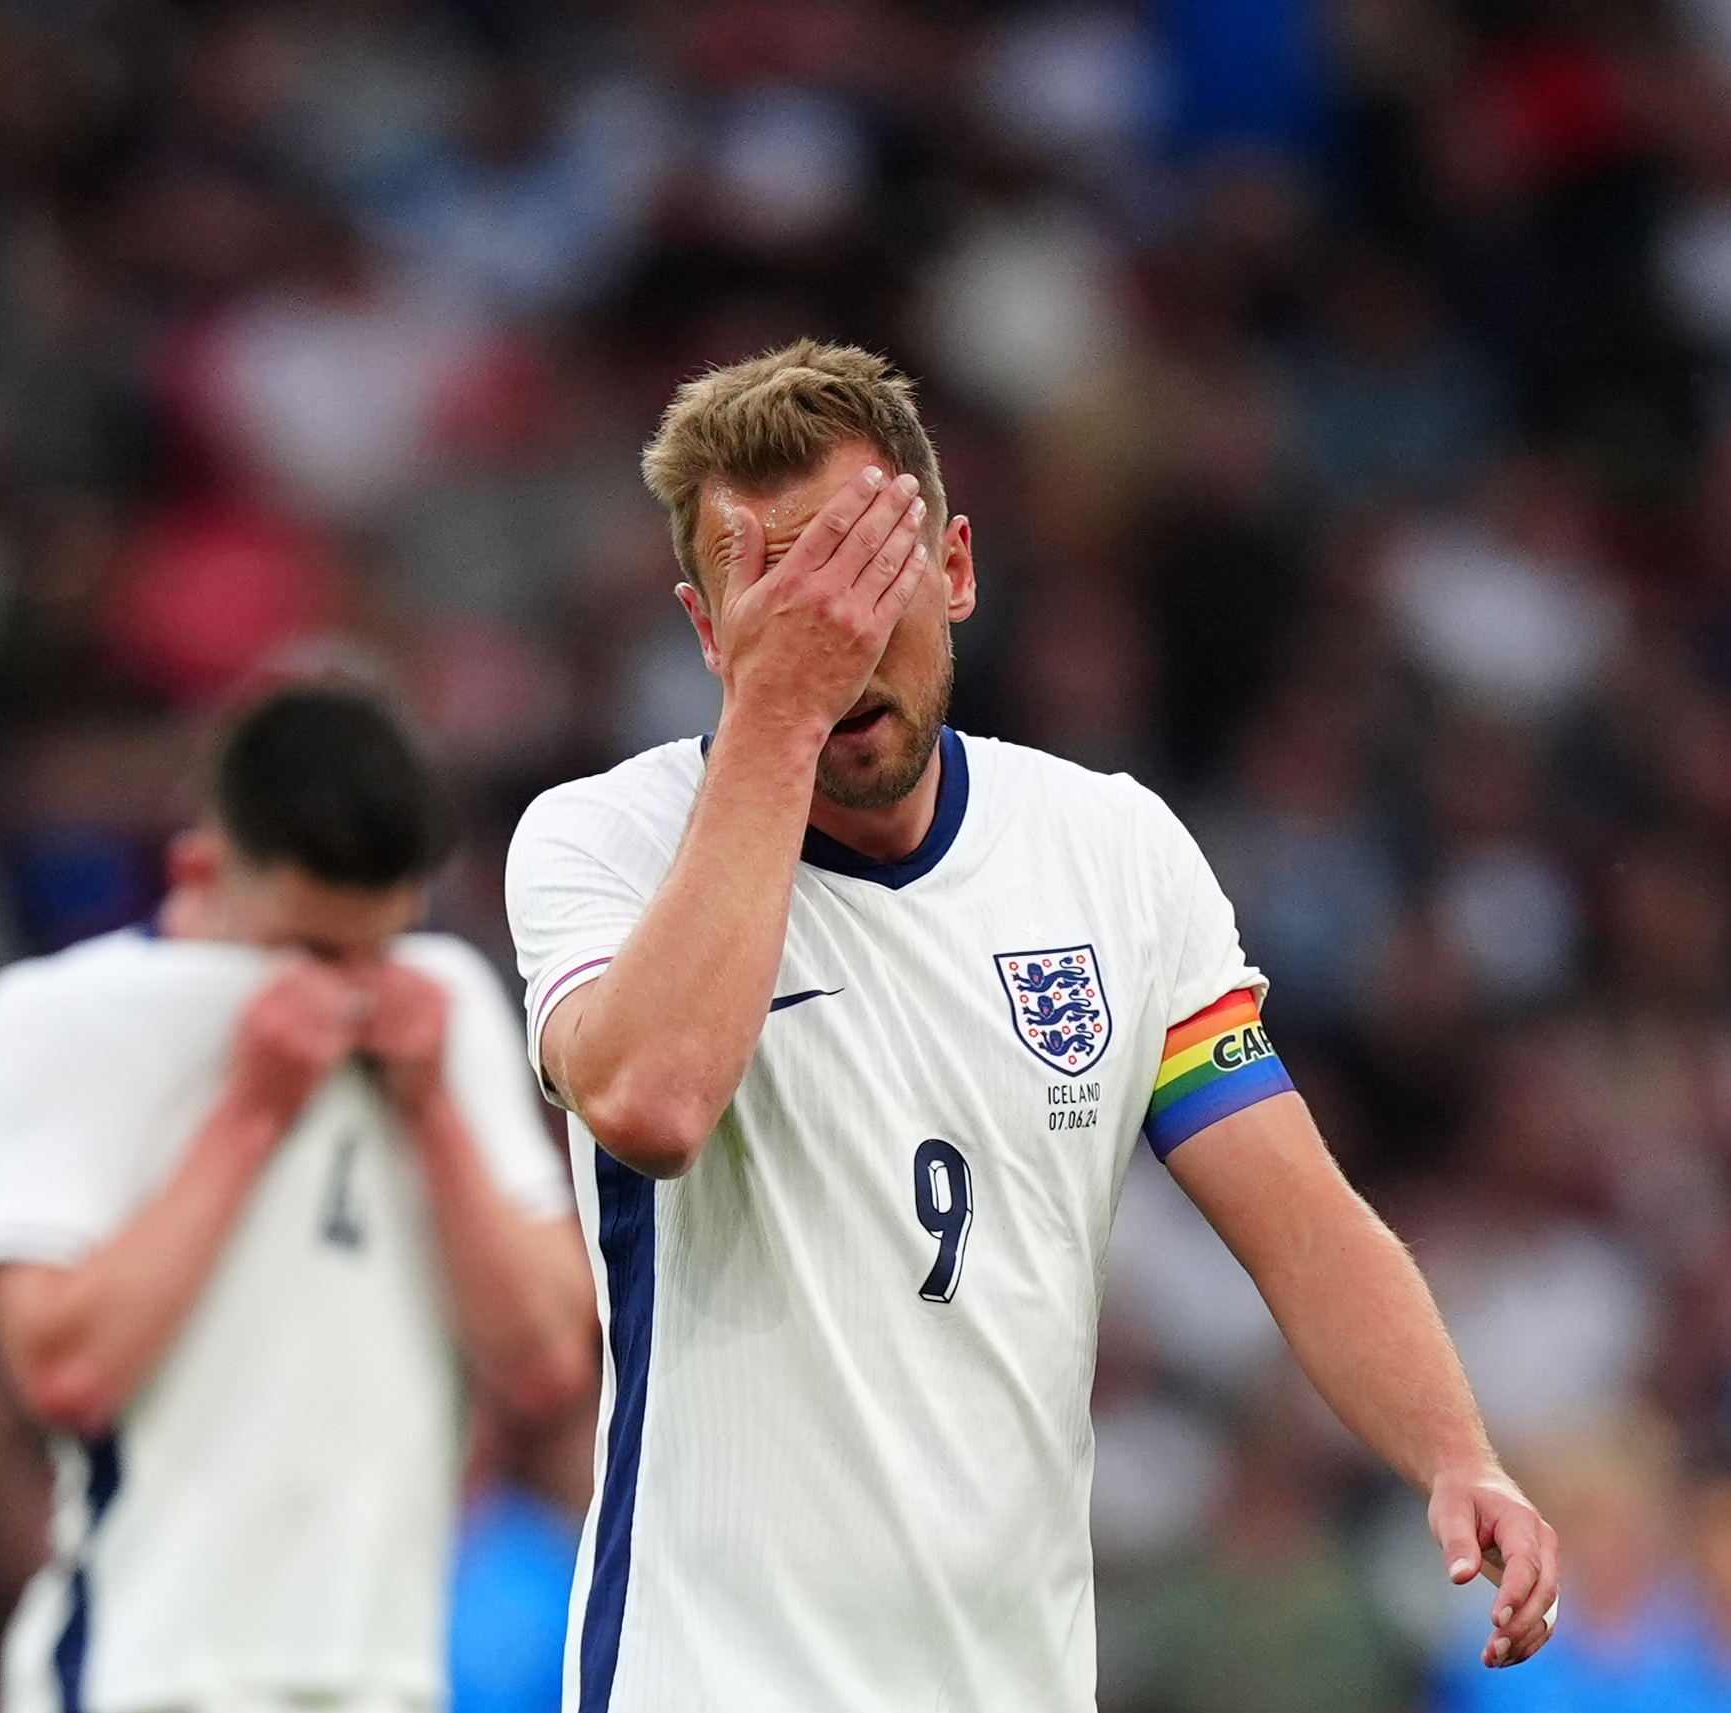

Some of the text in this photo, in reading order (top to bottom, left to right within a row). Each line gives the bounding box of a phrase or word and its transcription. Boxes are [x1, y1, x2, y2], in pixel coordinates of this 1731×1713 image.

[1048, 1082, 1101, 1105] ICELAND
[1049, 1108, 1098, 1131] 07.06.24
[913, 1139, 973, 1304] 9
